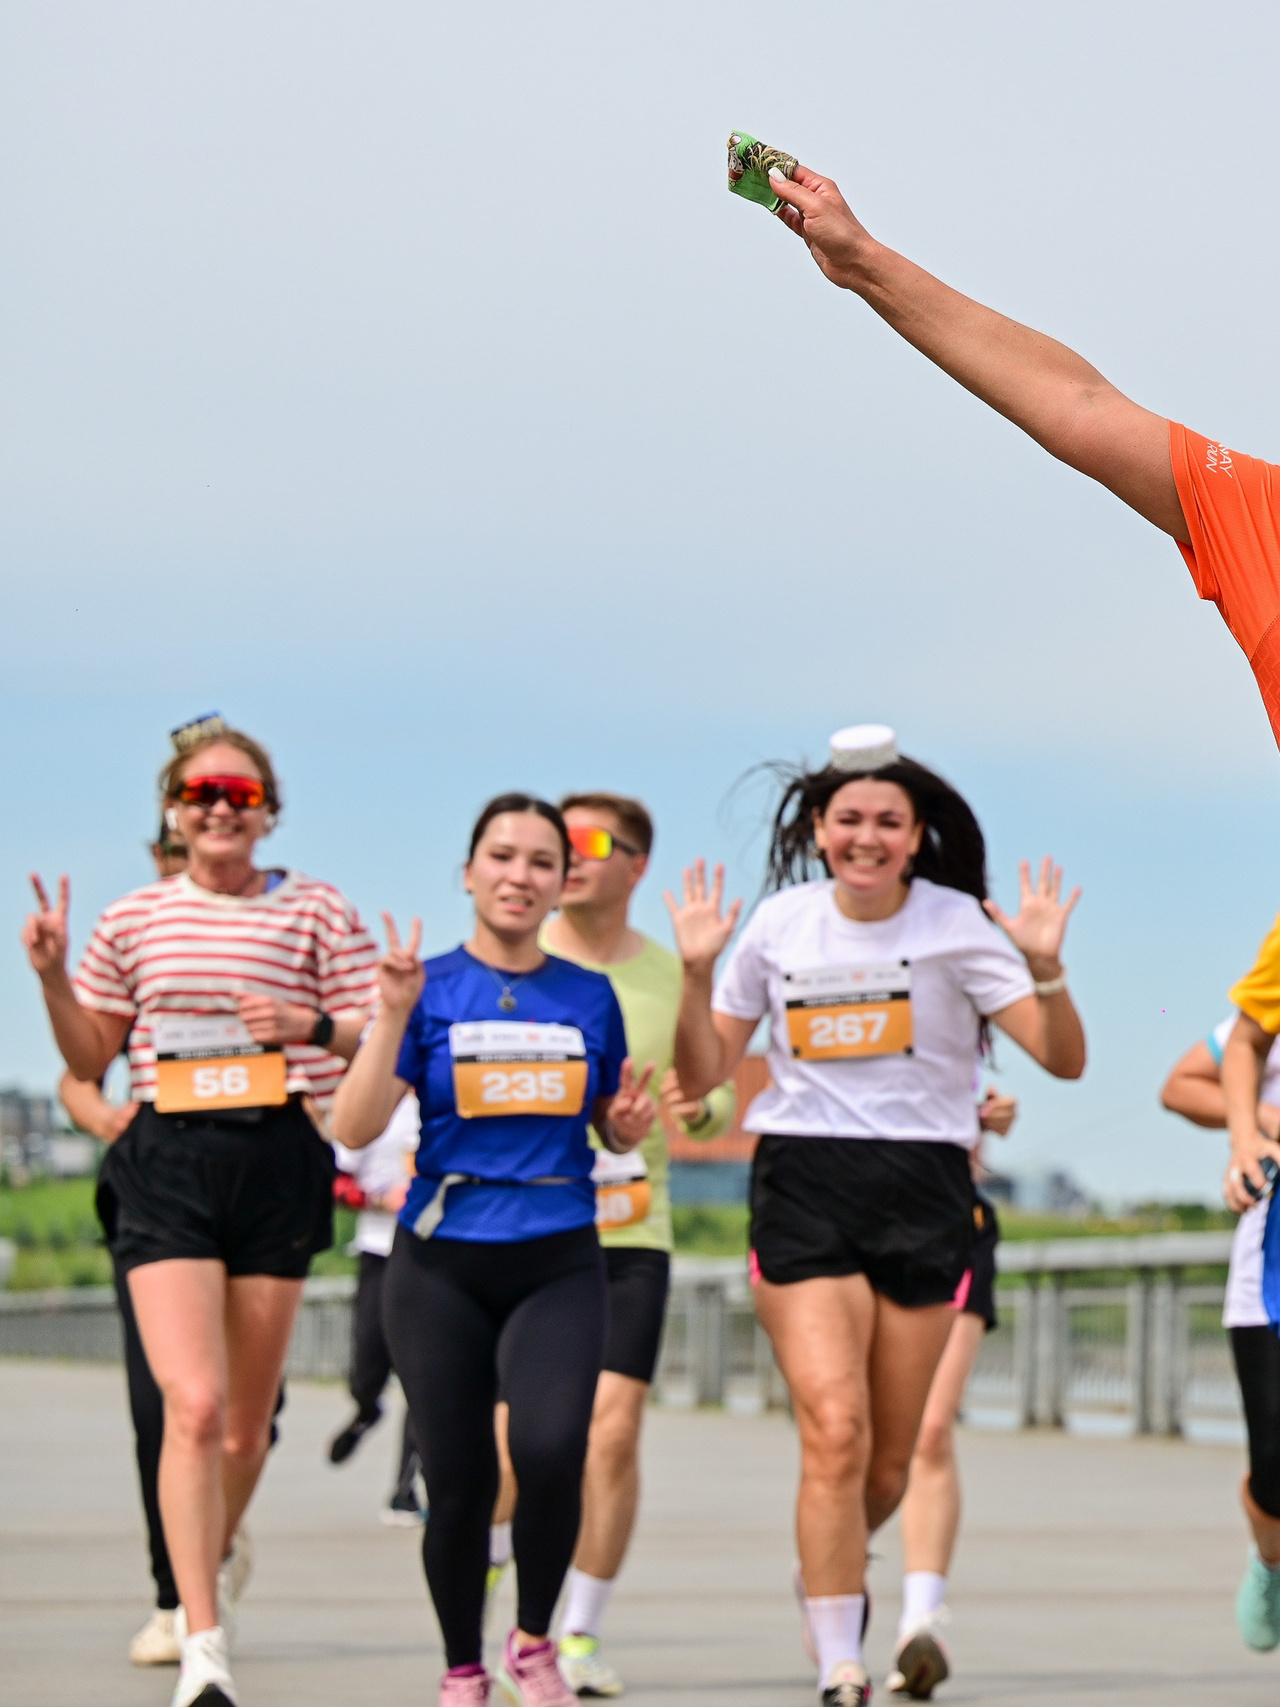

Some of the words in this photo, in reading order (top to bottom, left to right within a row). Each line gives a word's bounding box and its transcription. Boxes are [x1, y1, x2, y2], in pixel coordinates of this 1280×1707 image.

[808, 1010, 890, 1049] 267
[192, 1064, 250, 1098] 56
[481, 1071, 567, 1104] 235
